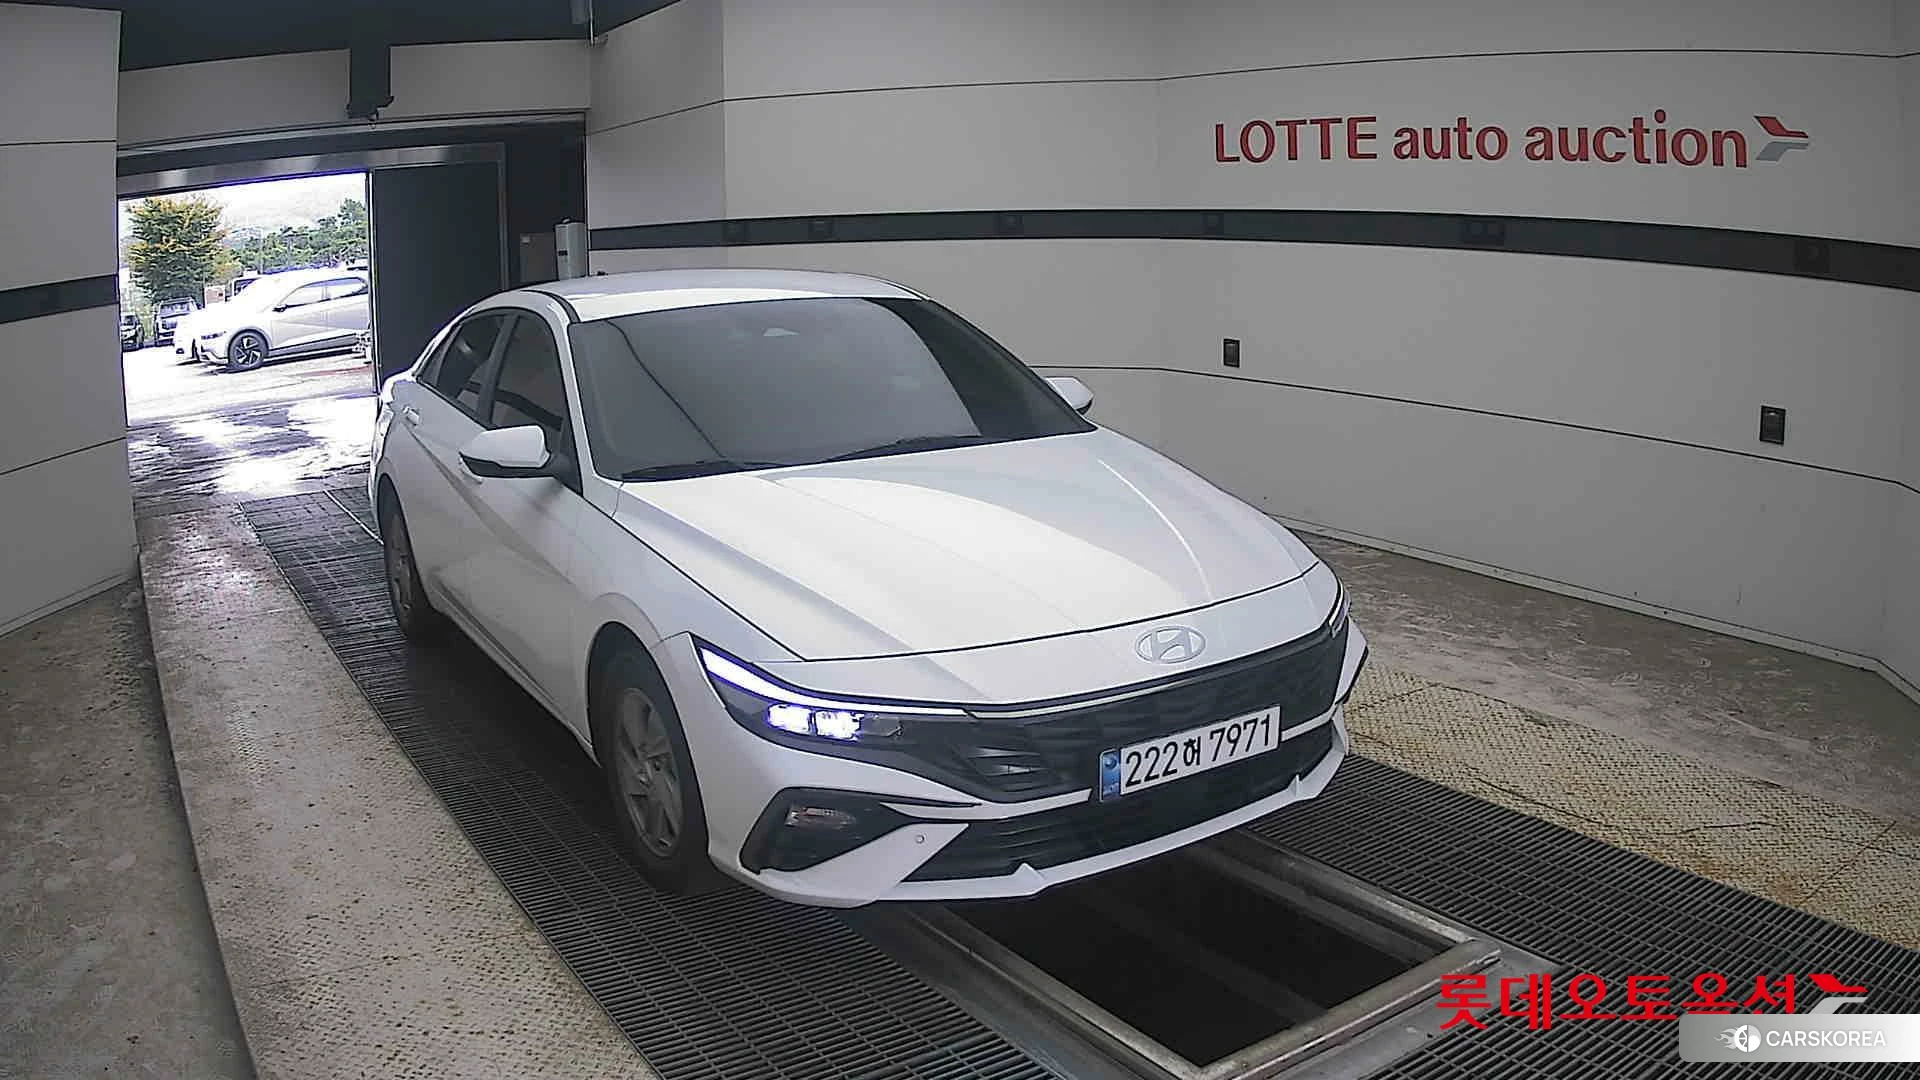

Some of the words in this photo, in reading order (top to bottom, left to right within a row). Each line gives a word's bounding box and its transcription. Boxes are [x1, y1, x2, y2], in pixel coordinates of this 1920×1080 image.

[1214, 116, 1378, 164] LOTTE
[1392, 116, 1509, 162] auto
[1524, 109, 1748, 169] auction
[1209, 714, 1271, 762] 7971
